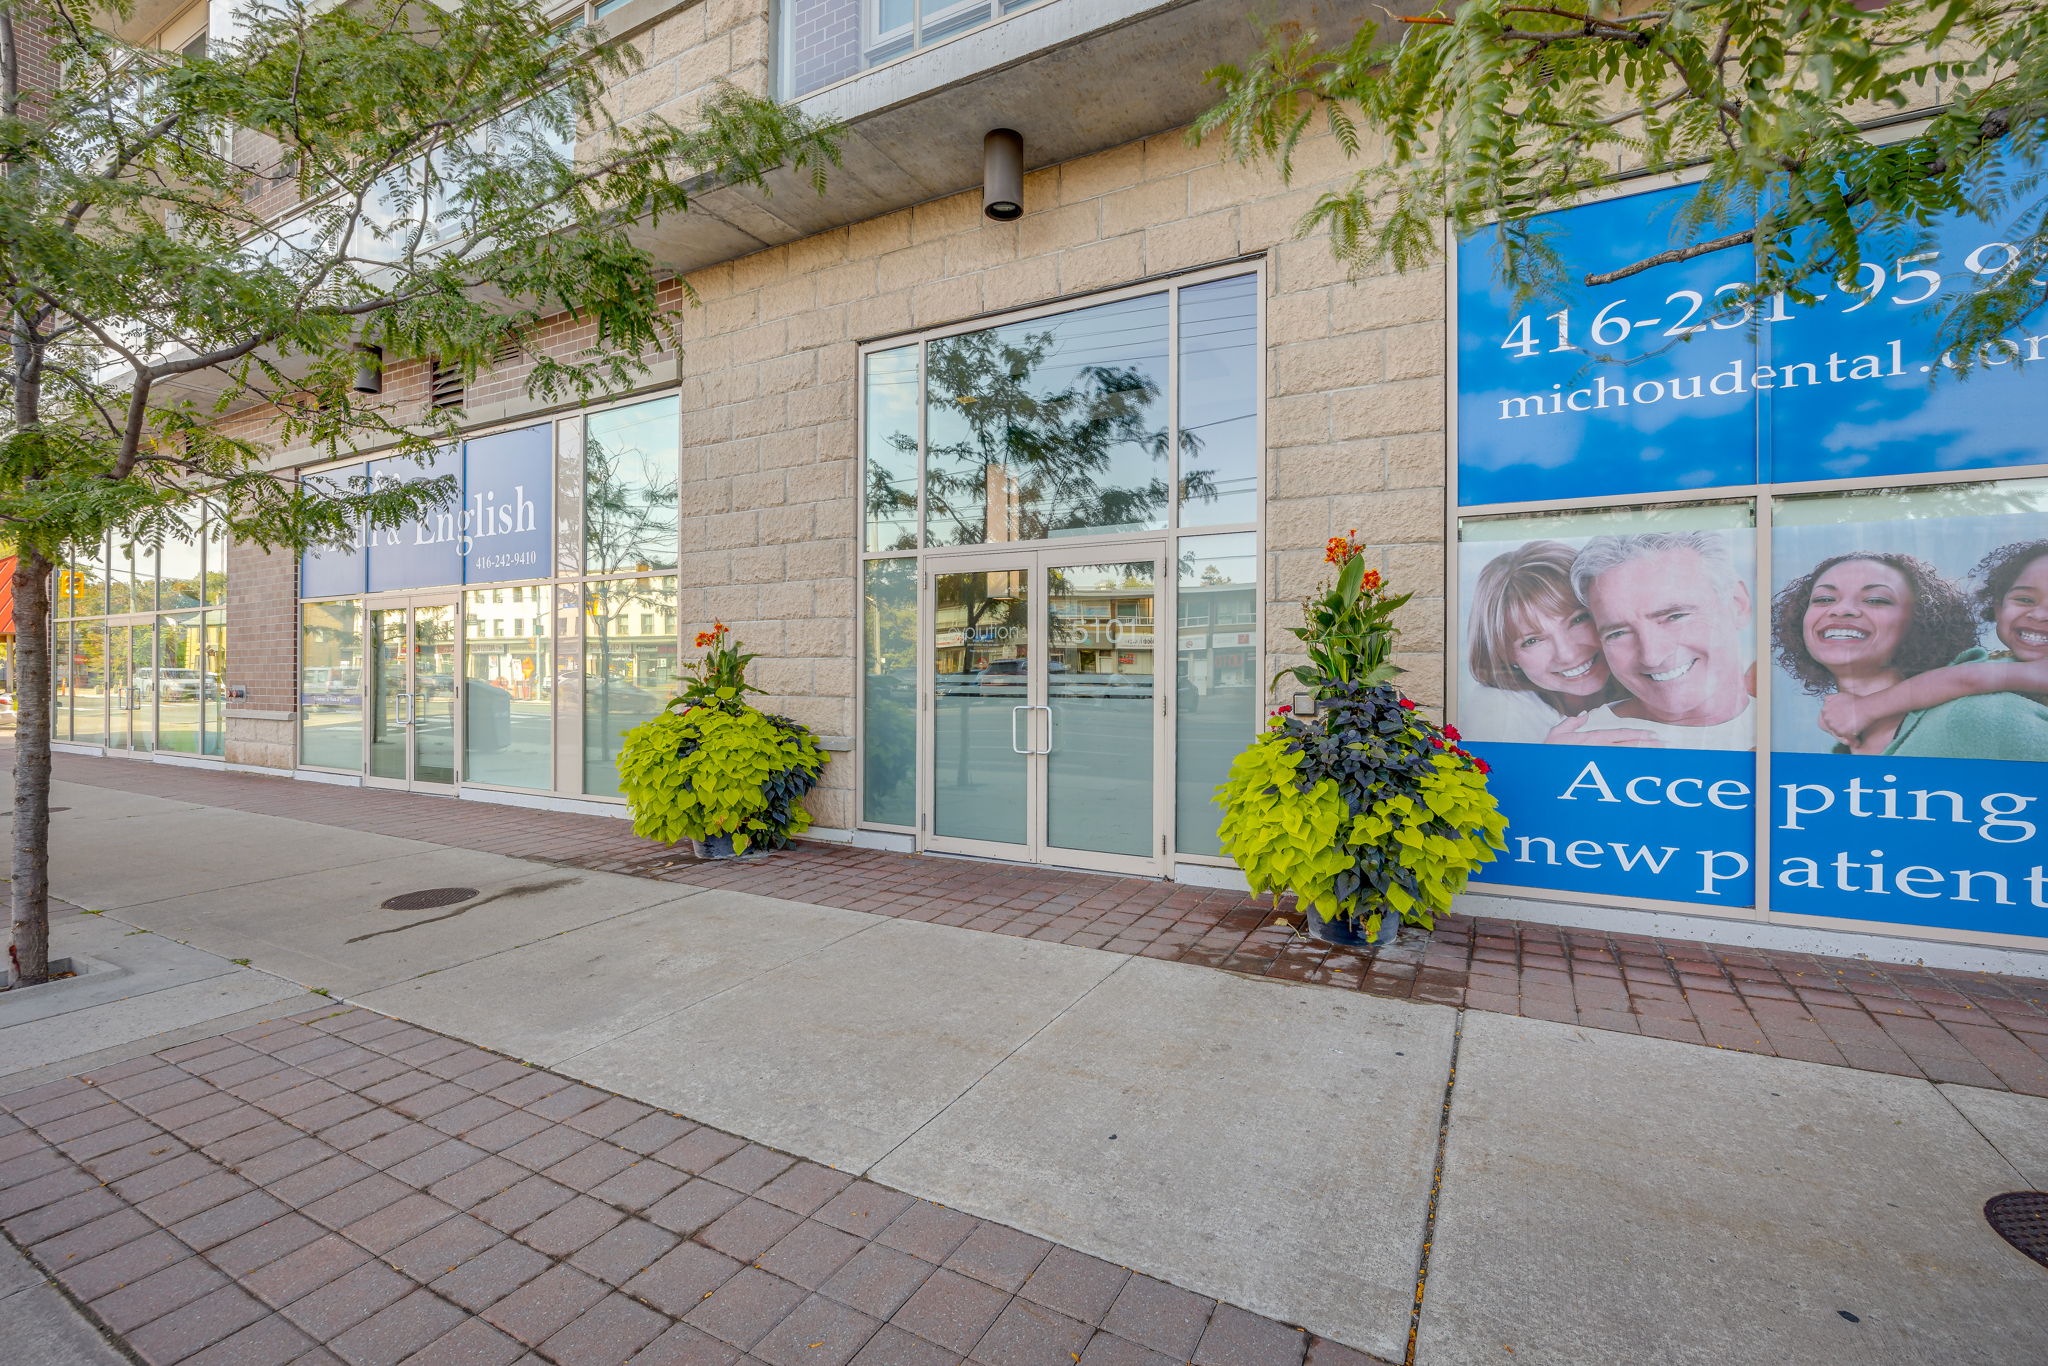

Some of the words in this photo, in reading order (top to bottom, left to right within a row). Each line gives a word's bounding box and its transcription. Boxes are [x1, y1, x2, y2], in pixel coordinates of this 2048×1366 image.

[413, 485, 537, 556] English
[475, 550, 537, 570] 416-242-9410
[1514, 835, 1680, 875] new
